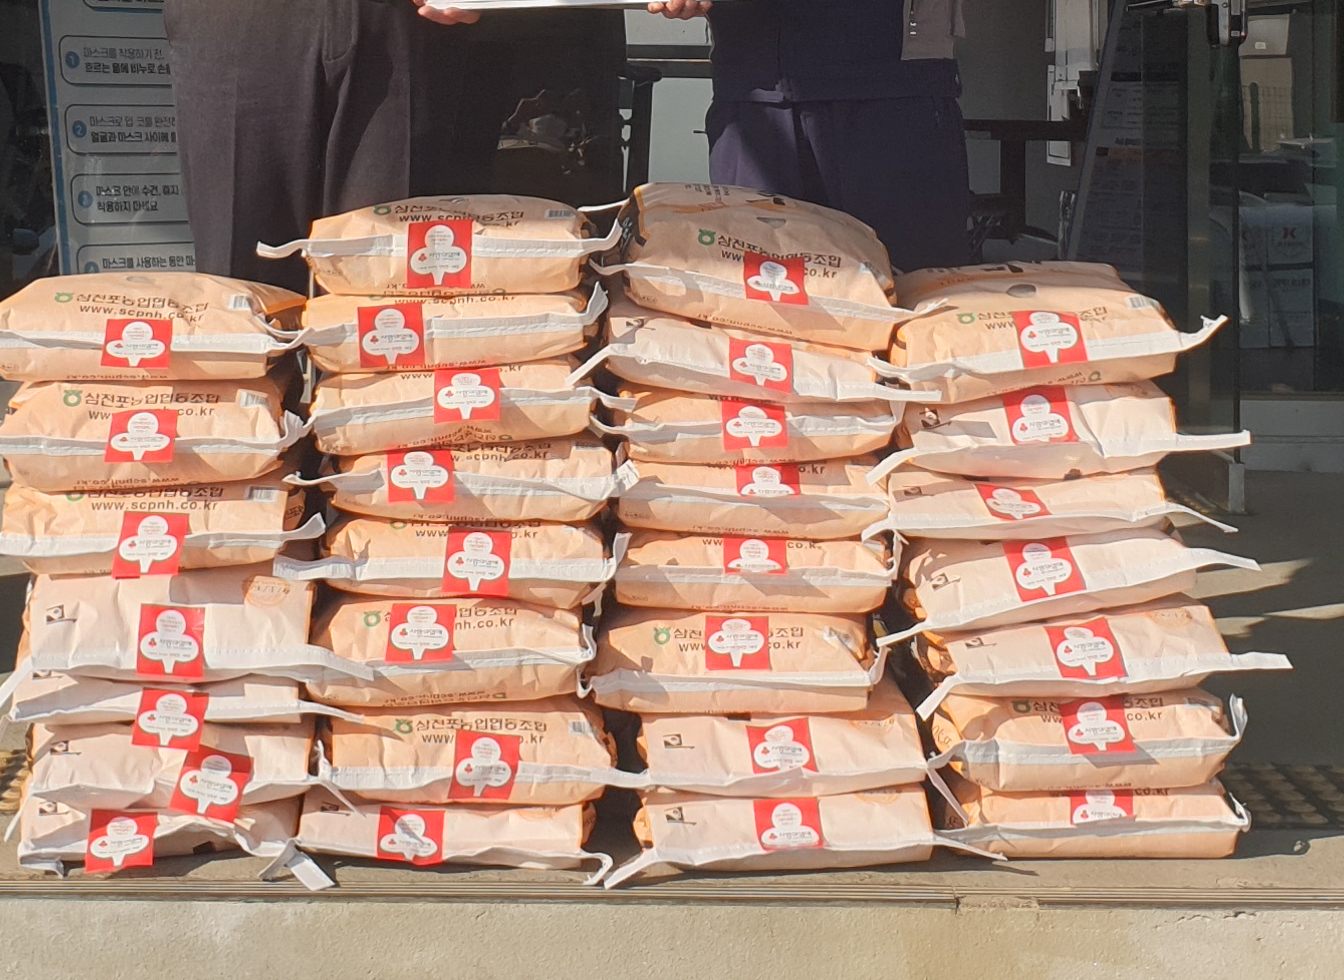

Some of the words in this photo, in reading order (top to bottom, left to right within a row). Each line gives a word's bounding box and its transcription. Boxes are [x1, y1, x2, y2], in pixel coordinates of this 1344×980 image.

[130, 63, 156, 74] 비누로
[117, 131, 143, 142] 마스크
[102, 258, 134, 269] 마스크를
[90, 499, 220, 513] www.scpnh.co.kr
